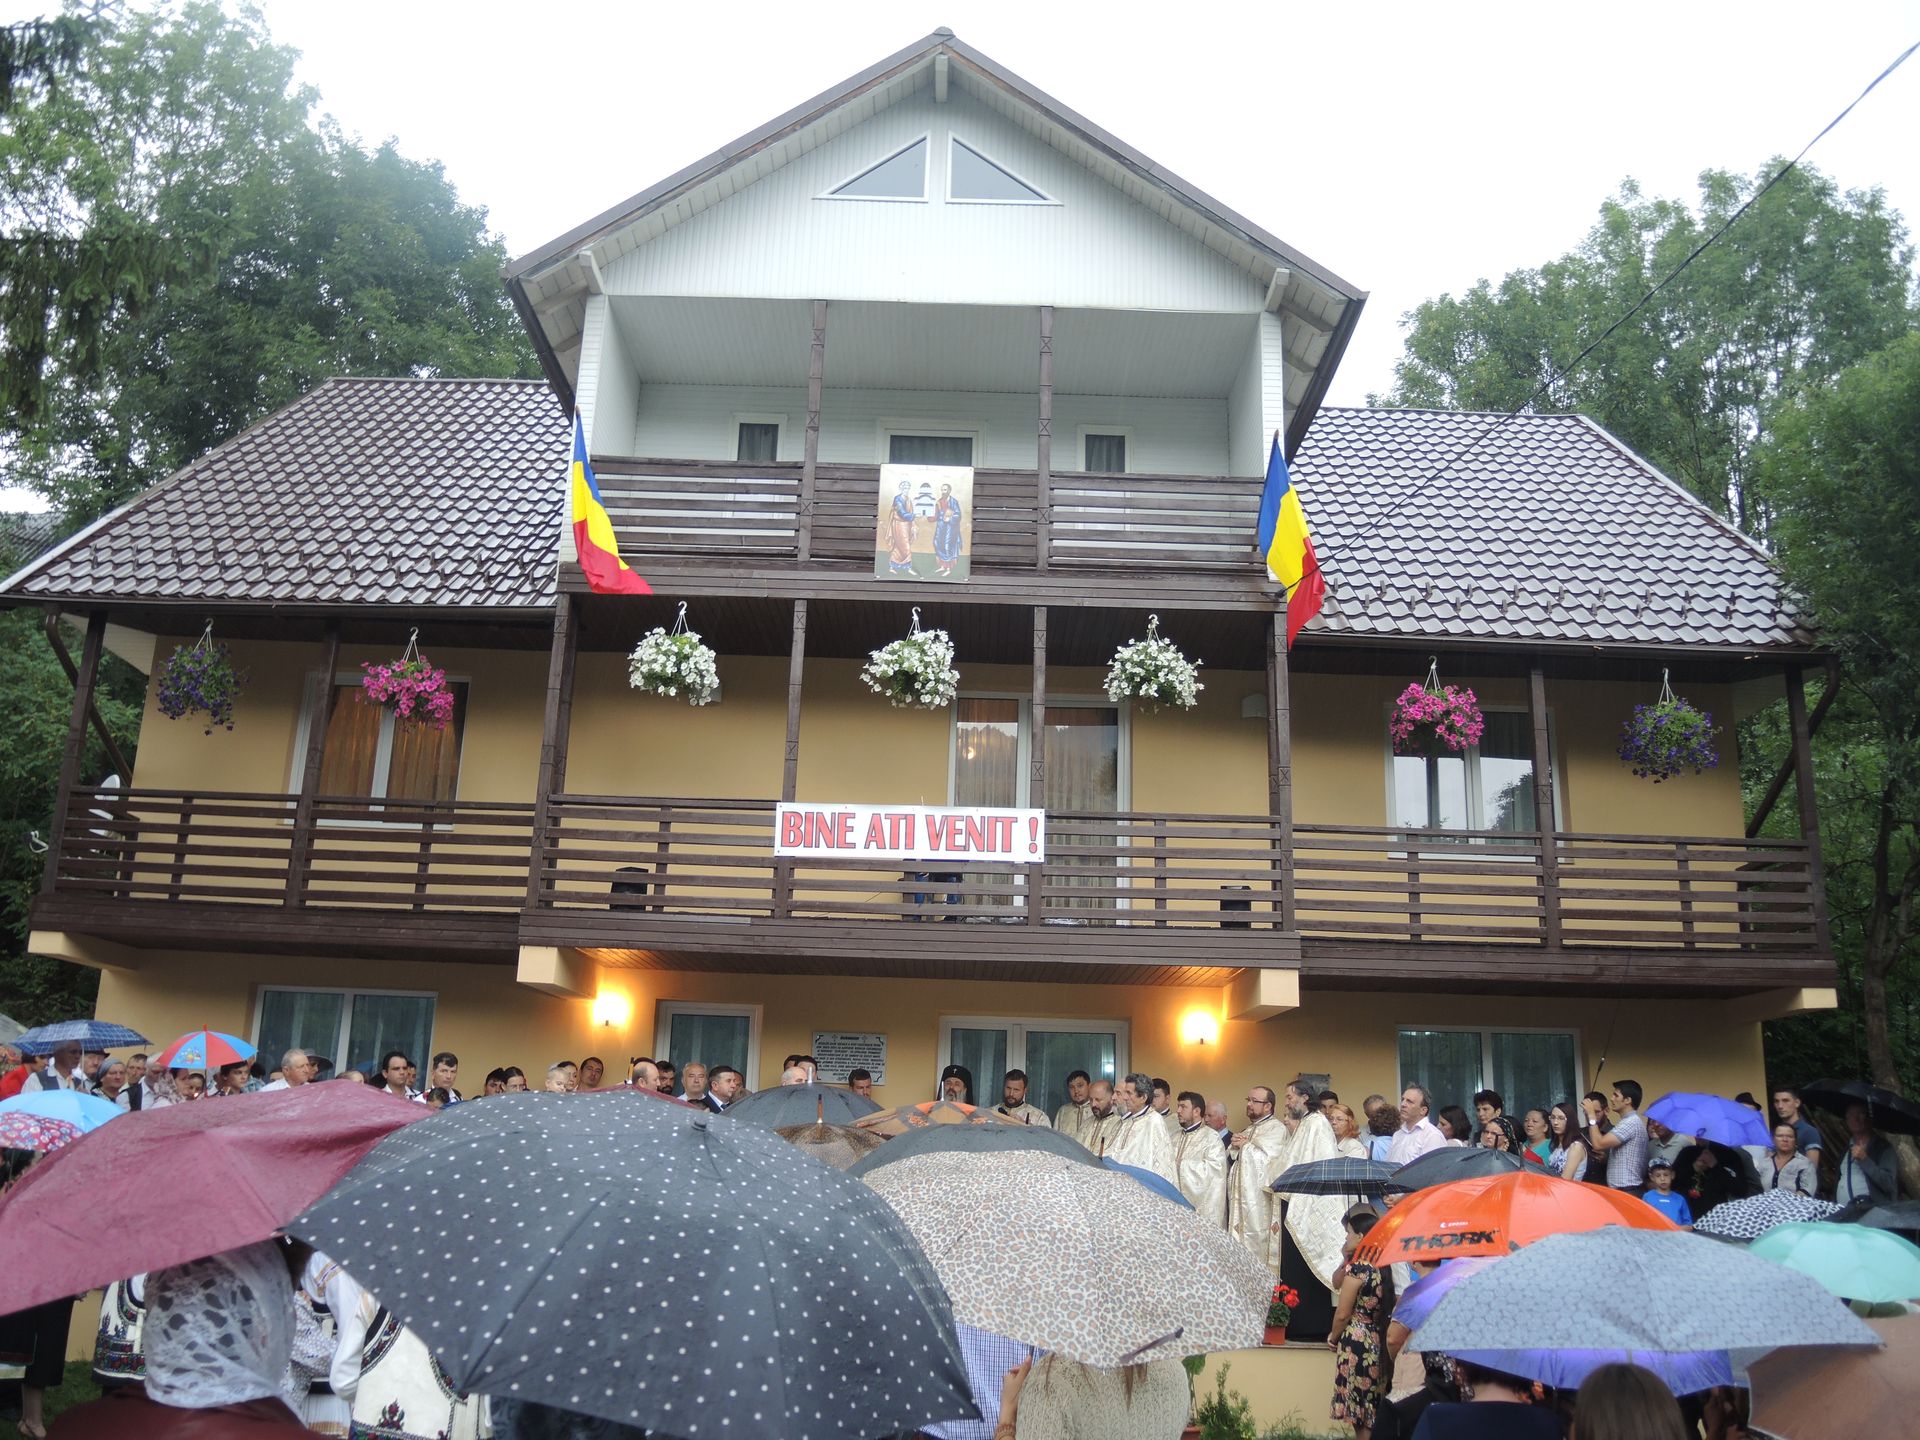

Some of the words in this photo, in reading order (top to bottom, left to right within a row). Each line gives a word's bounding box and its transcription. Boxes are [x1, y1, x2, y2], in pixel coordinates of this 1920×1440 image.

[781, 811, 856, 849] BINE
[864, 812, 916, 850] ATI
[926, 814, 1018, 853] VENIT
